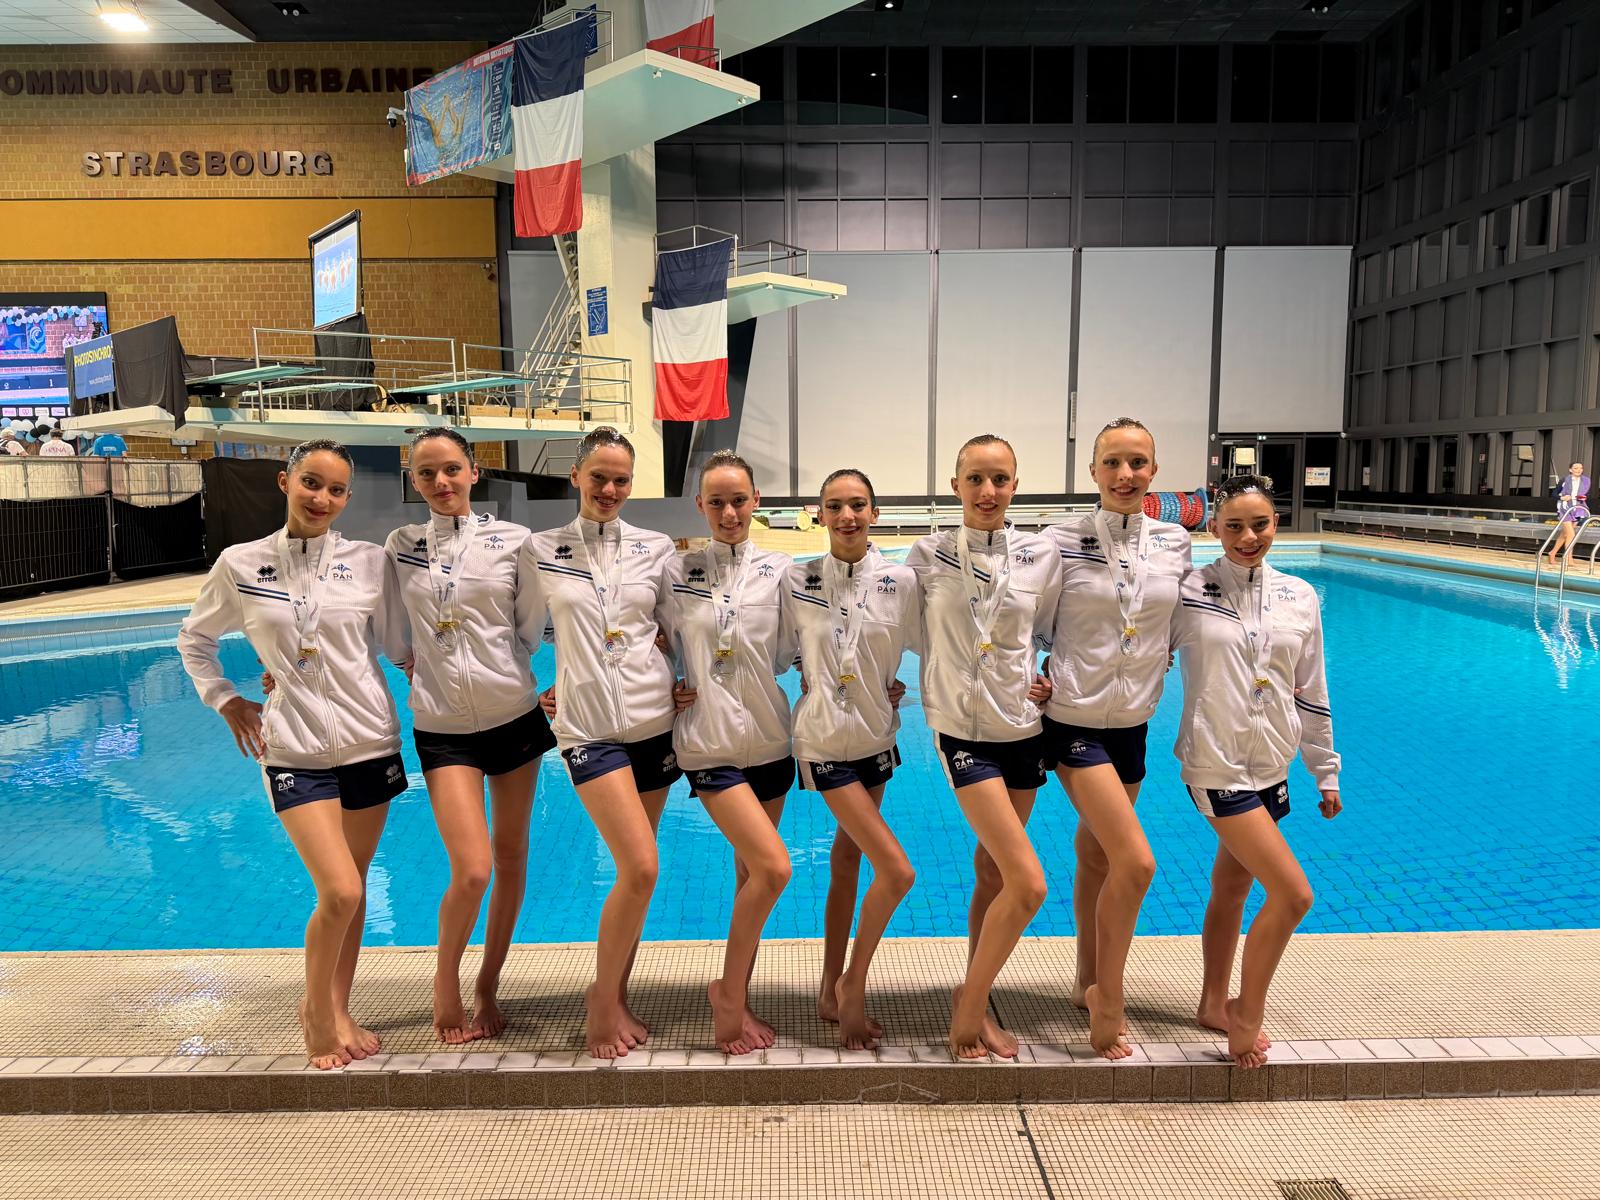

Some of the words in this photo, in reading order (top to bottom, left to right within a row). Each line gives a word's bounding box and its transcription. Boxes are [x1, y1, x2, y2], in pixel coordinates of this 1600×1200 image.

[82, 150, 333, 176] STRASBOURG
[1015, 555, 1034, 563] PAN
[571, 753, 588, 767] PAN
[955, 758, 975, 771] PAN
[816, 763, 834, 775] PAN
[278, 779, 294, 792] PAN
